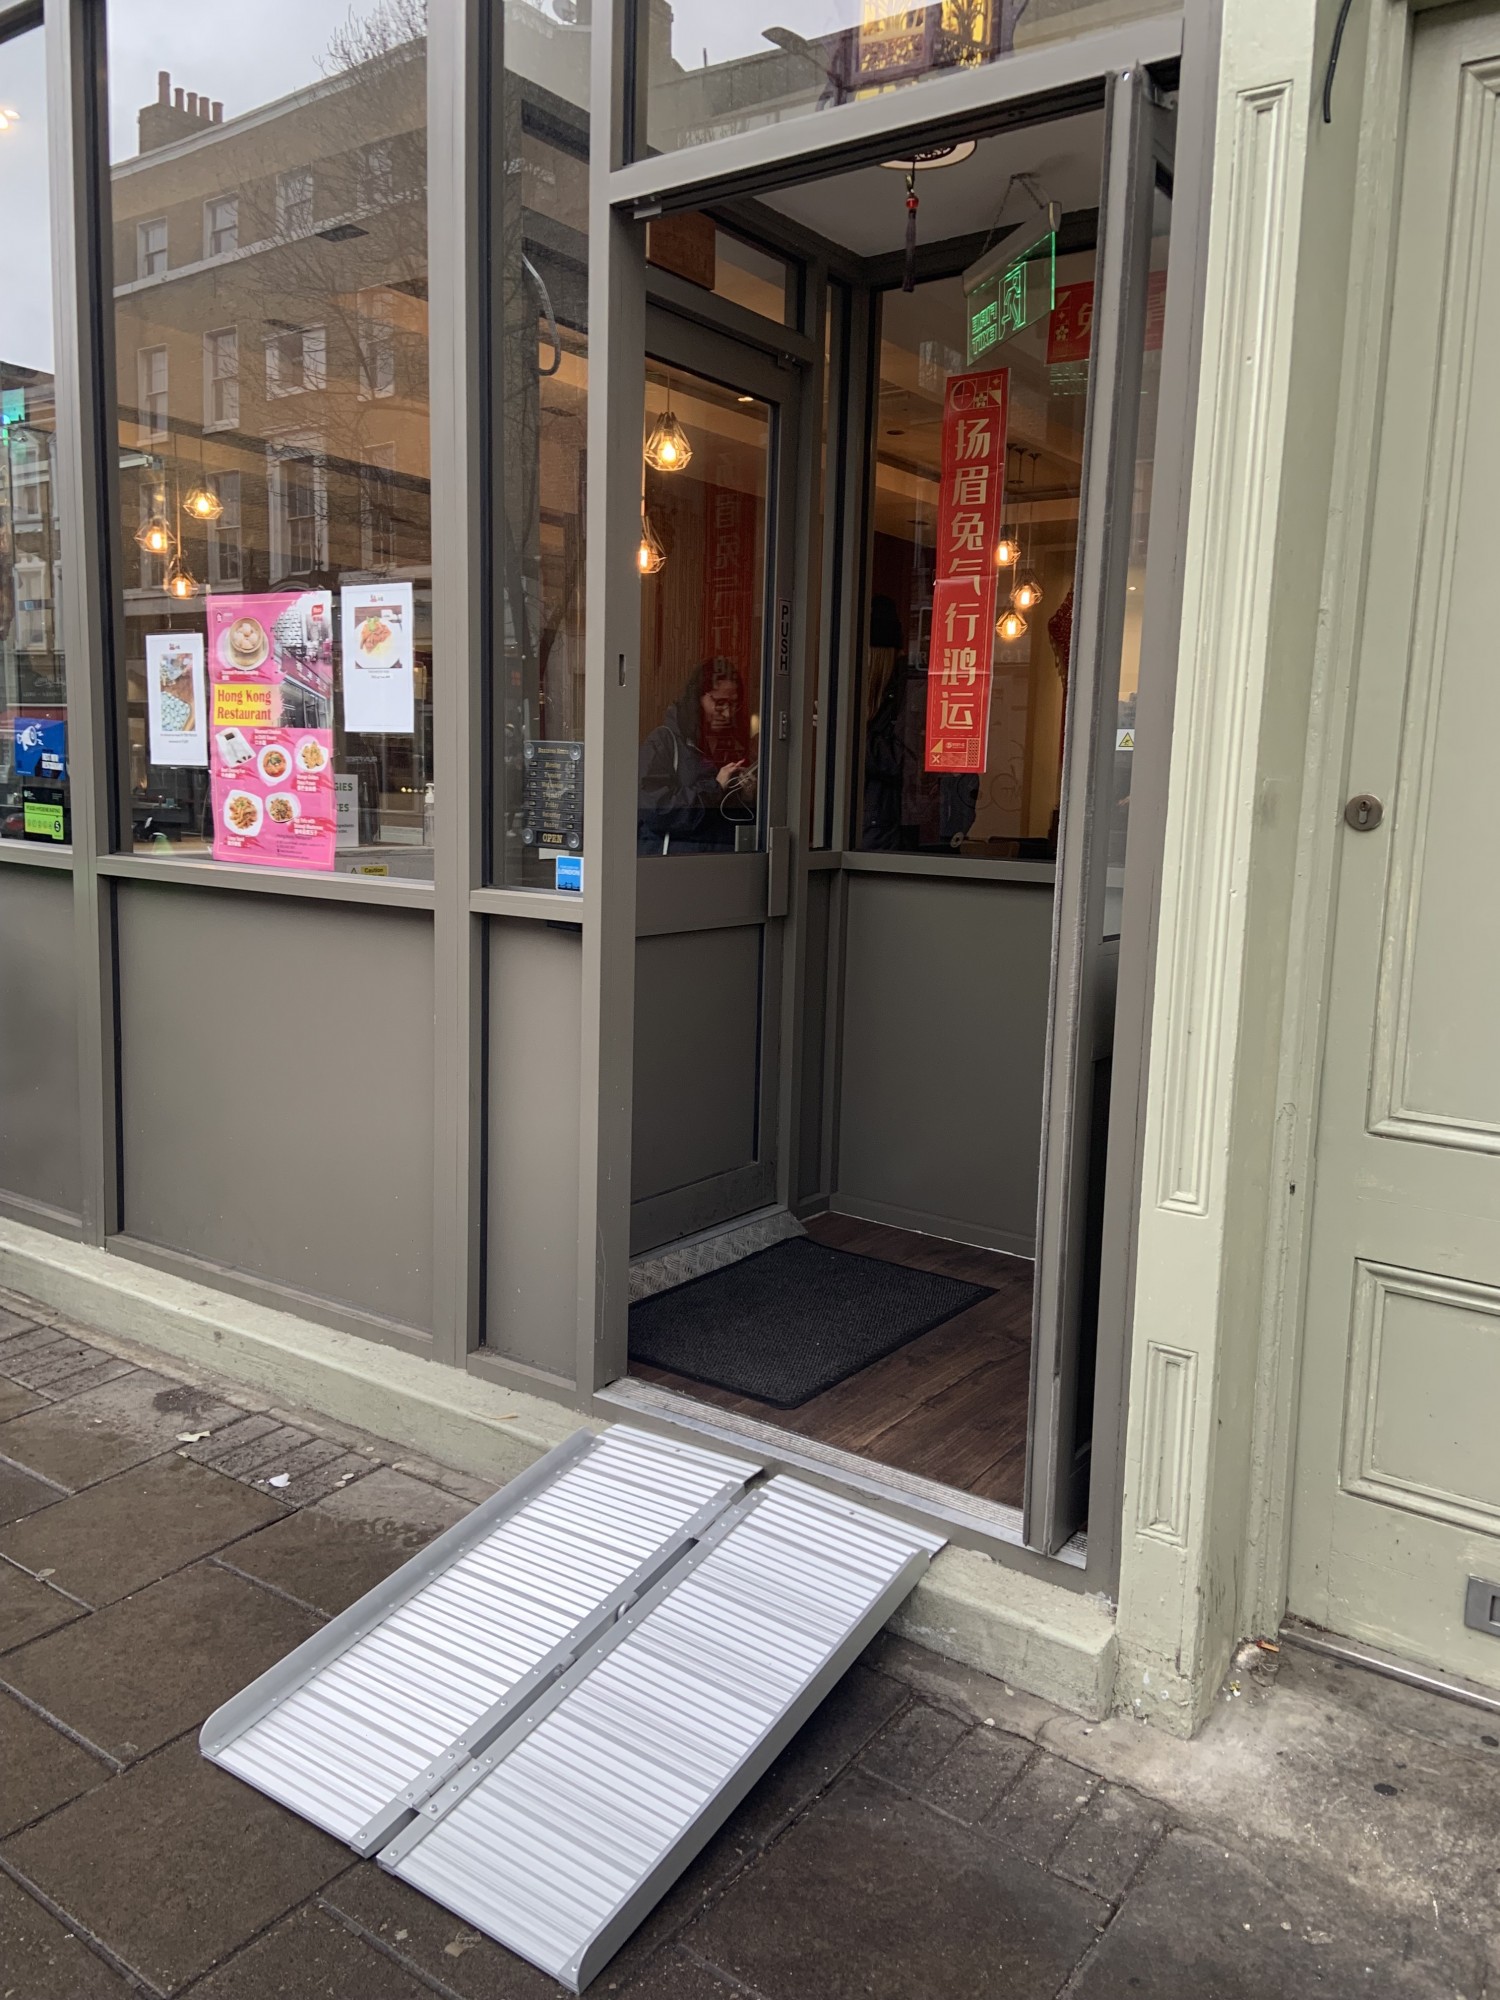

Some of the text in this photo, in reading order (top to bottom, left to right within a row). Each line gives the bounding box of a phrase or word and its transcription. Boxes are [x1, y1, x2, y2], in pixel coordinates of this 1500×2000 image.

[940, 418, 991, 730] 扬眉兔气行鸿运
[780, 605, 789, 671] PUSH
[217, 689, 272, 705] Hong Kong
[217, 706, 272, 721] Restaurant
[542, 833, 563, 844] OPEN
[364, 866, 384, 874] Caution
